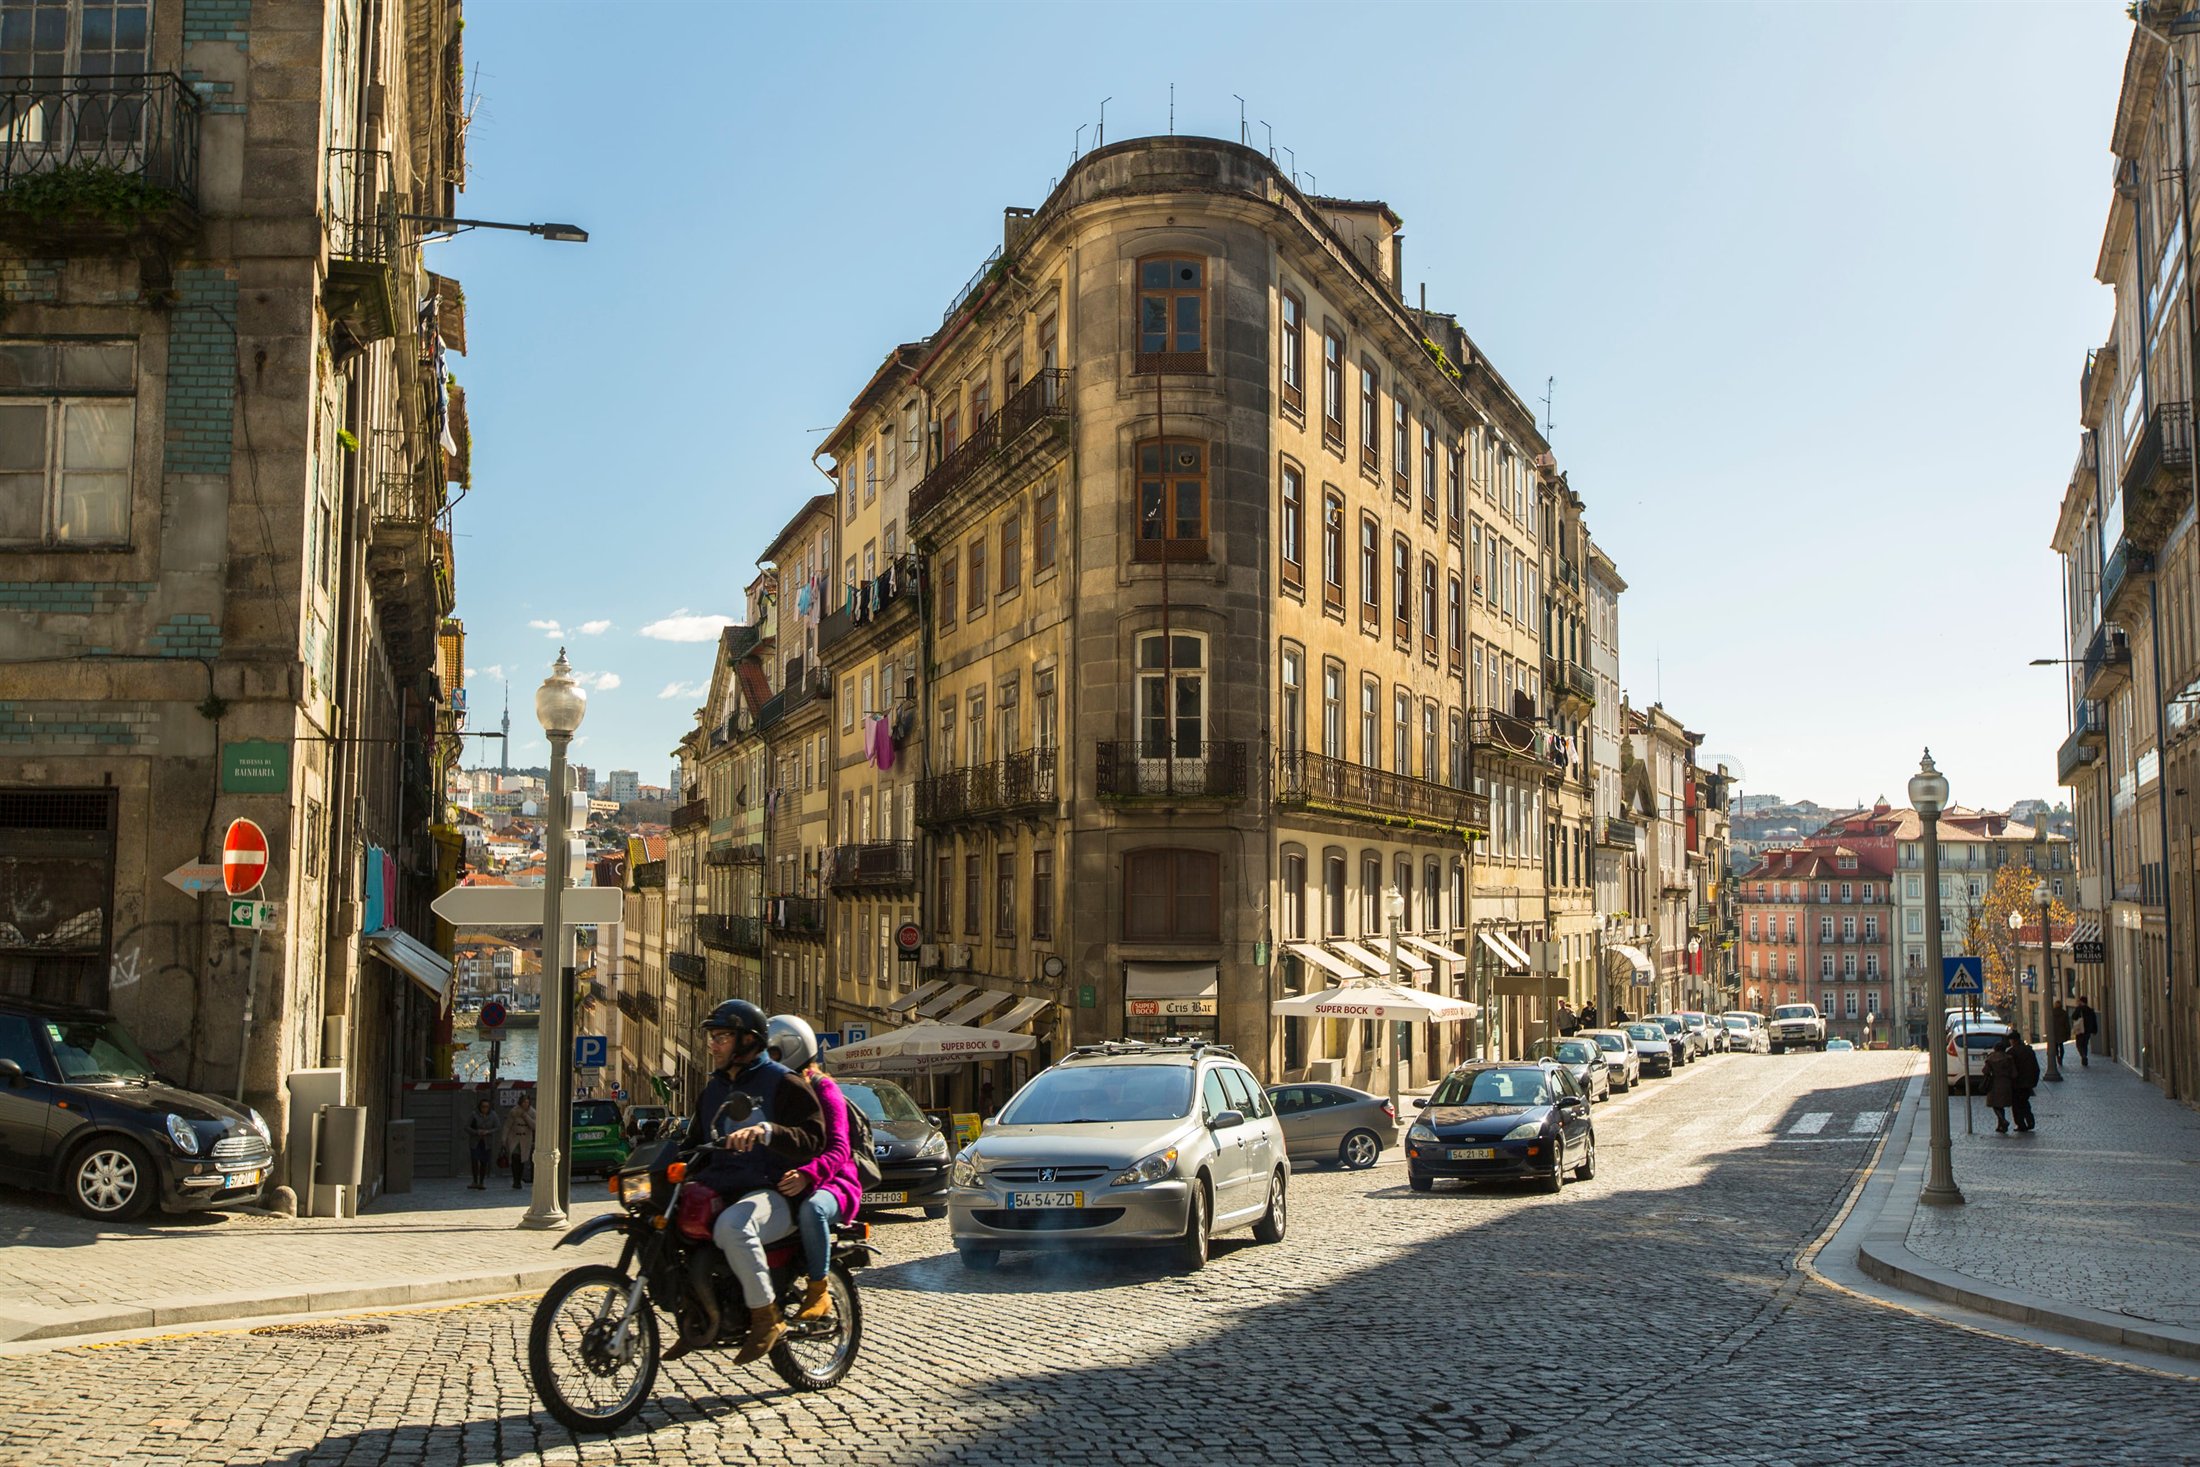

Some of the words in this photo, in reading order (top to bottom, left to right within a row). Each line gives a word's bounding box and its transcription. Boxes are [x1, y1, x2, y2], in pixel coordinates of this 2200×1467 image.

[1166, 1002, 1188, 1013] Cris
[1191, 1002, 1212, 1013] Bar
[1315, 1005, 1342, 1014] SUPER
[1344, 1006, 1368, 1015] BOCK
[853, 1032, 863, 1043] P
[582, 1039, 600, 1064] P
[941, 1042, 965, 1051] SUPER
[966, 1041, 987, 1050] BOCK
[846, 1051, 859, 1059] SUPER
[860, 1048, 873, 1057] BOCK
